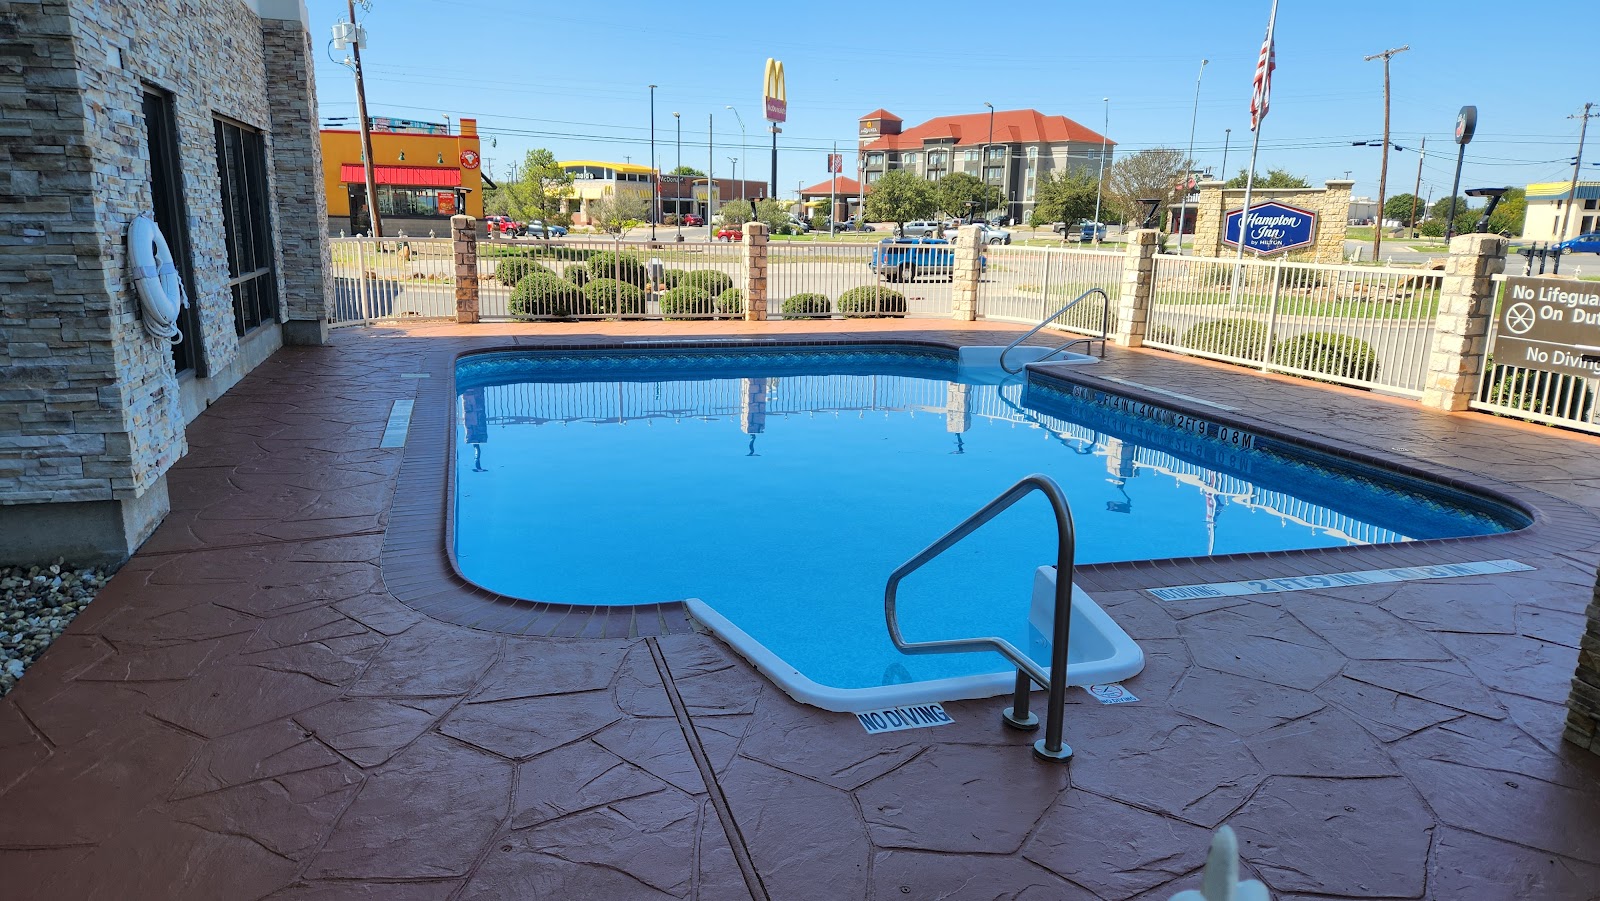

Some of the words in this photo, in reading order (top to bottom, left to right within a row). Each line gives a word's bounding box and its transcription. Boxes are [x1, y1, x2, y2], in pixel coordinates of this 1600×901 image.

[1238, 213, 1302, 229] Hampton
[1251, 226, 1285, 239] Inn
[1513, 285, 1535, 300] No
[1539, 287, 1600, 308] Lifegua
[1540, 305, 1564, 321] On
[1526, 347, 1548, 363] No
[858, 712, 888, 731] NO
[883, 705, 952, 728] DIVING
